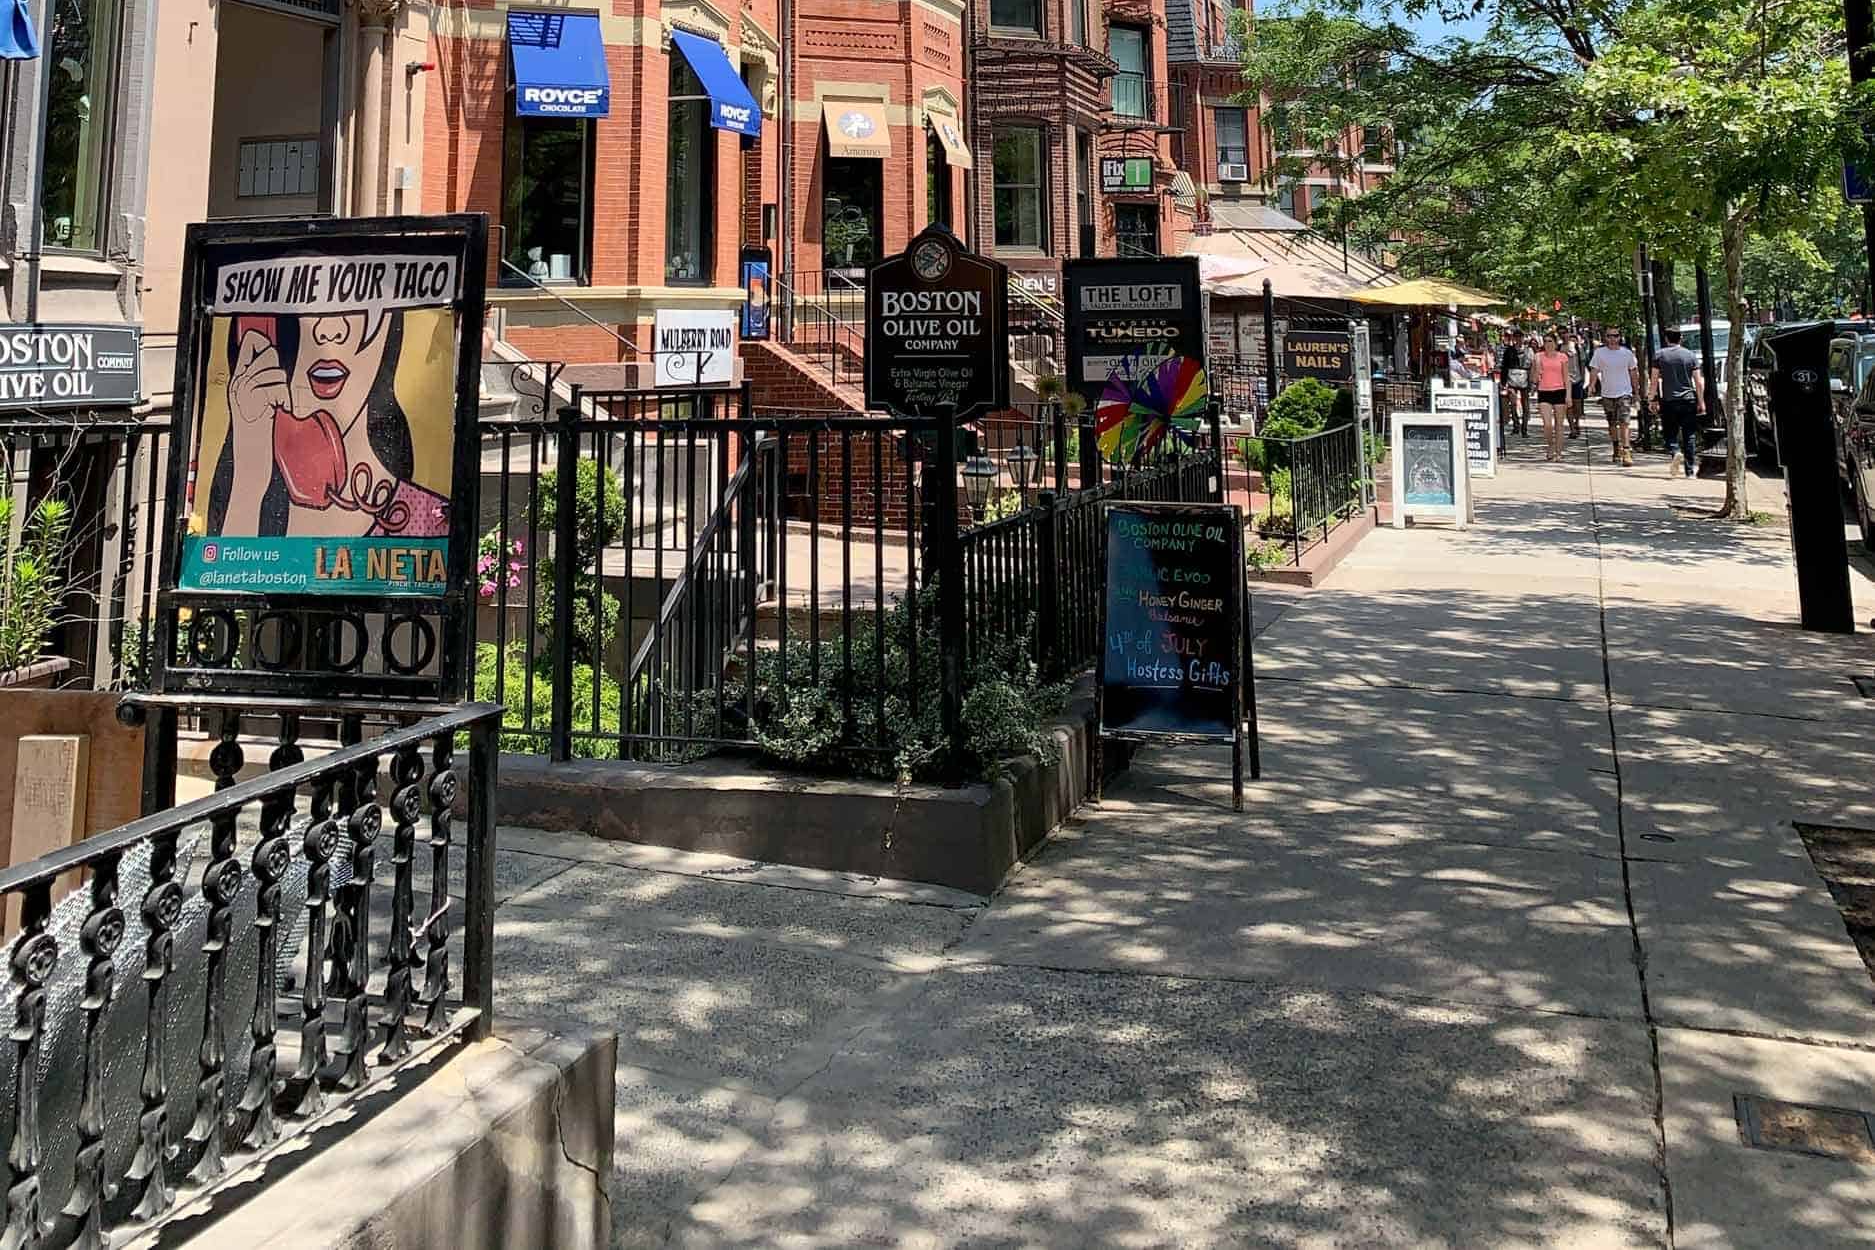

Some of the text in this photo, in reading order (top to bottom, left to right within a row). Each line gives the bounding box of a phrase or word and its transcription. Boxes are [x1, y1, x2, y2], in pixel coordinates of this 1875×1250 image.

[540, 105, 586, 113] CHOCOLATE
[223, 261, 449, 303] SHOW ME YOUR TACO
[1085, 286, 1177, 303] THE LOFT
[881, 291, 983, 316] BOSTON
[883, 320, 981, 336] OLIVE OIL
[1086, 327, 1180, 338] TUXEDO
[661, 328, 732, 350] MULBERRY ROAD
[905, 340, 959, 350] COMPANY
[1288, 342, 1349, 353] LAUREN'S
[97, 356, 134, 369] COMPANY
[1296, 355, 1342, 368] NAILS
[890, 367, 974, 380] Extra Virgin Olive Oil
[1798, 371, 1811, 382] 31
[52, 371, 94, 396] OIL
[903, 378, 936, 389] Balsamic
[938, 378, 969, 390] Vinegar
[1118, 519, 1225, 543] BOSTON OLIVE OIL
[1134, 538, 1196, 552] COMPANY
[222, 547, 280, 562] Follow us
[314, 546, 448, 582] LA NETA
[200, 569, 307, 592] @lanetaboston
[1138, 589, 1177, 608] HONEY
[1179, 590, 1223, 613] GINGER
[1136, 630, 1153, 655] of
[1160, 631, 1208, 656] JULY
[1127, 656, 1230, 686] Hostess Gifts
